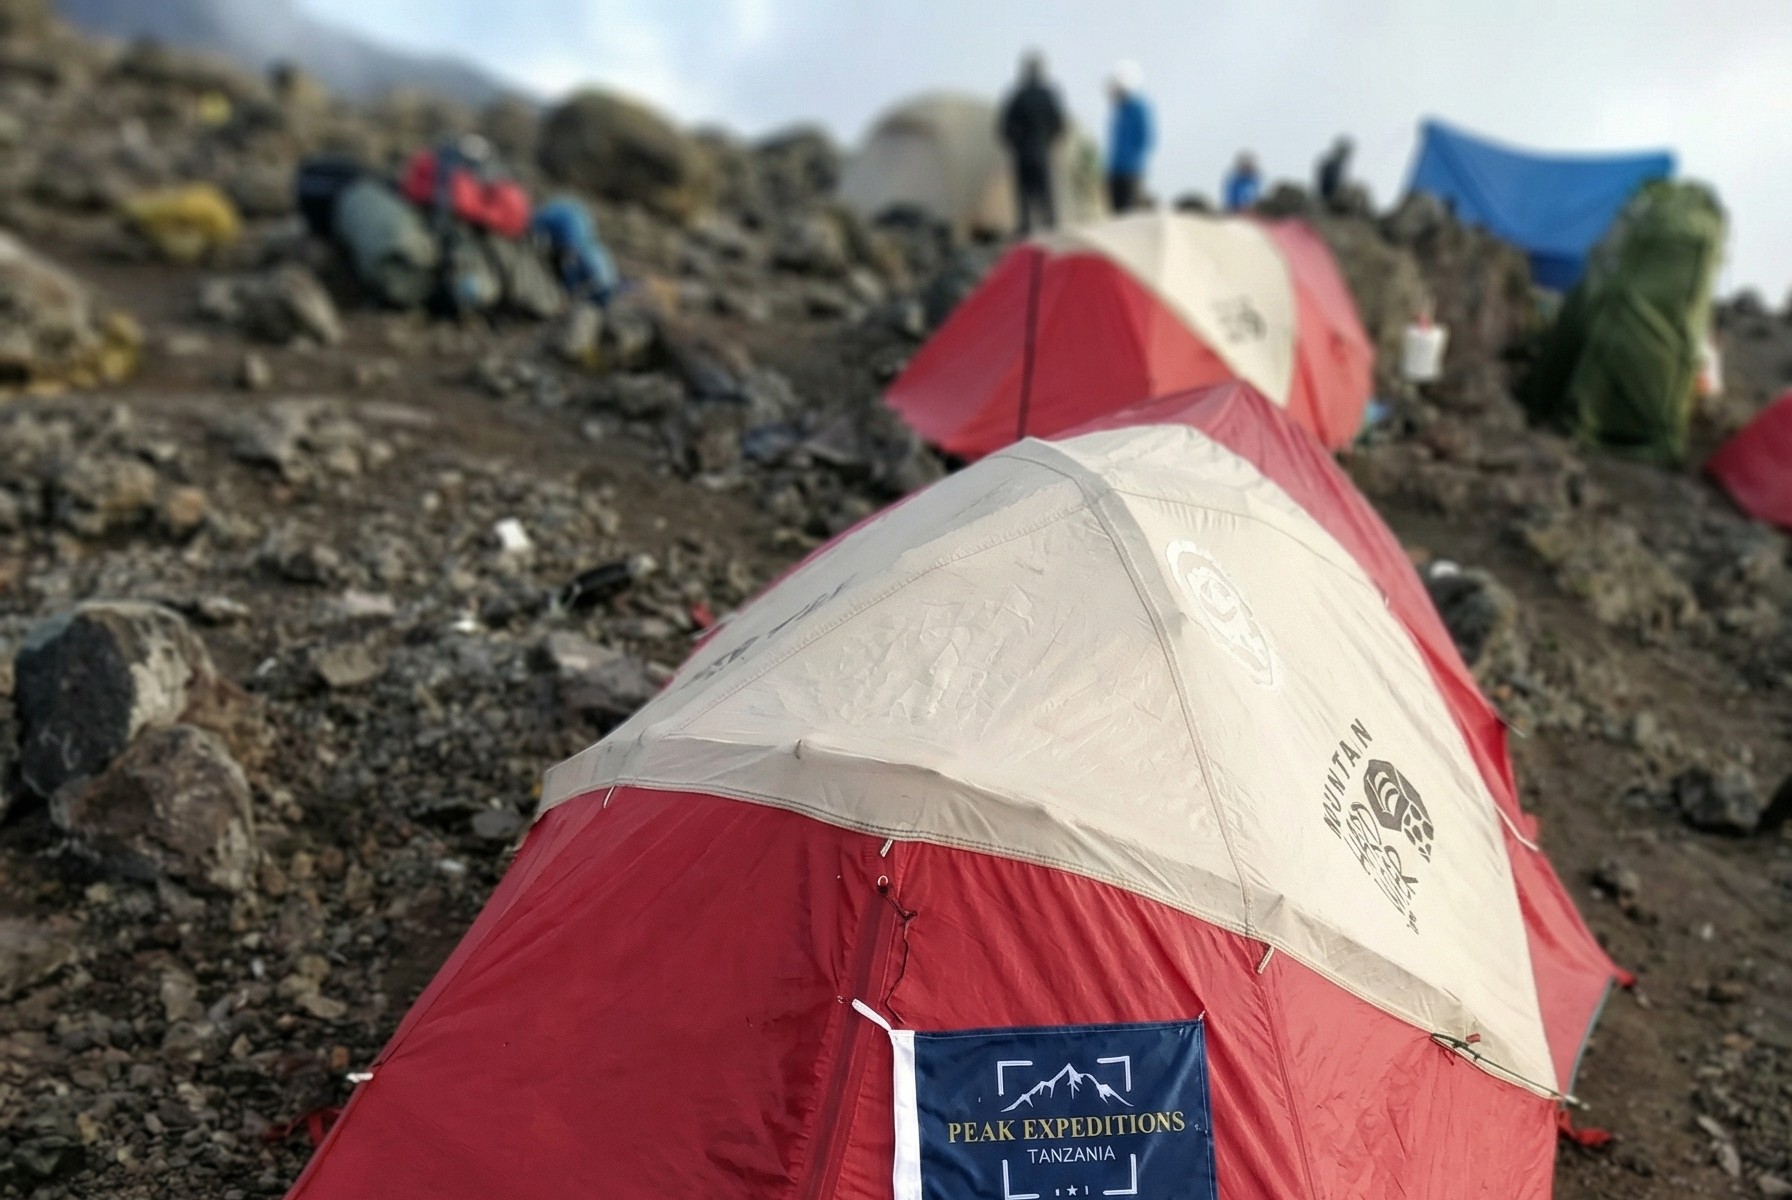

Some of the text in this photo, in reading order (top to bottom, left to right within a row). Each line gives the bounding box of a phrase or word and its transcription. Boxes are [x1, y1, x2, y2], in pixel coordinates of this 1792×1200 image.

[948, 1111, 1186, 1143] PEAK EXPEDITIONS
[1027, 1145, 1116, 1164] TANZANIA
